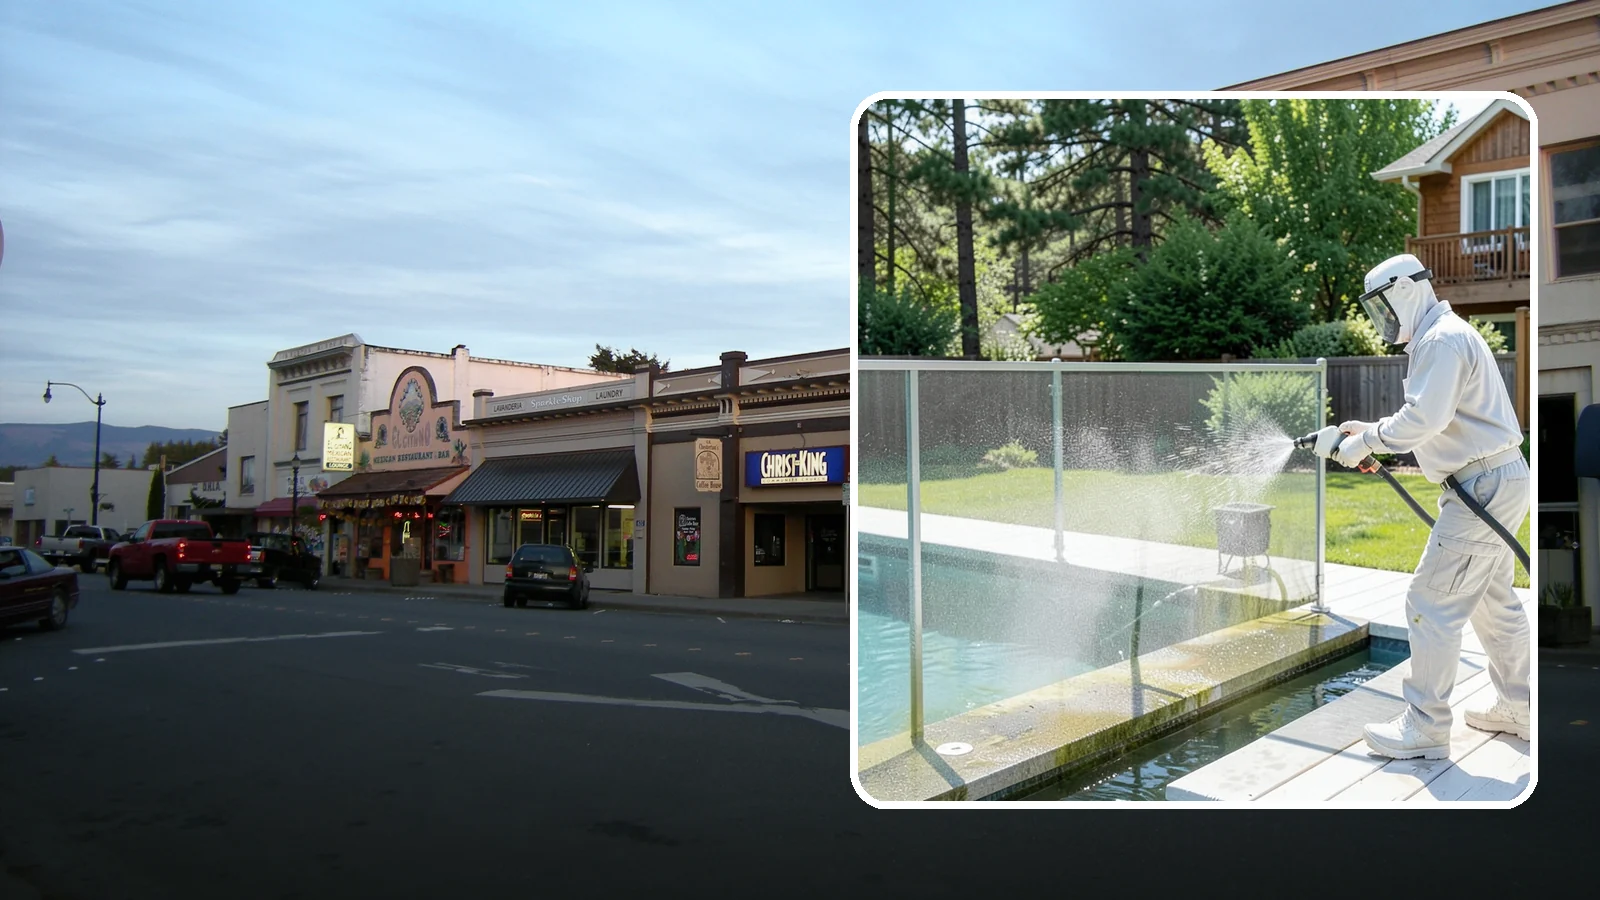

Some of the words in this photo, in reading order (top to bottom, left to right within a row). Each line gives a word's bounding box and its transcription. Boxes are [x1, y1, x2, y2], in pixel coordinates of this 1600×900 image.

[562, 394, 582, 404] Shop
[596, 389, 623, 400] LAUNDRY
[494, 402, 522, 412] LAVANDERIA
[374, 455, 396, 464] MEXICAN
[397, 451, 433, 462] RESTAURANT
[438, 450, 450, 459] BAR
[761, 452, 797, 478] CHRIST
[799, 450, 827, 476] KING
